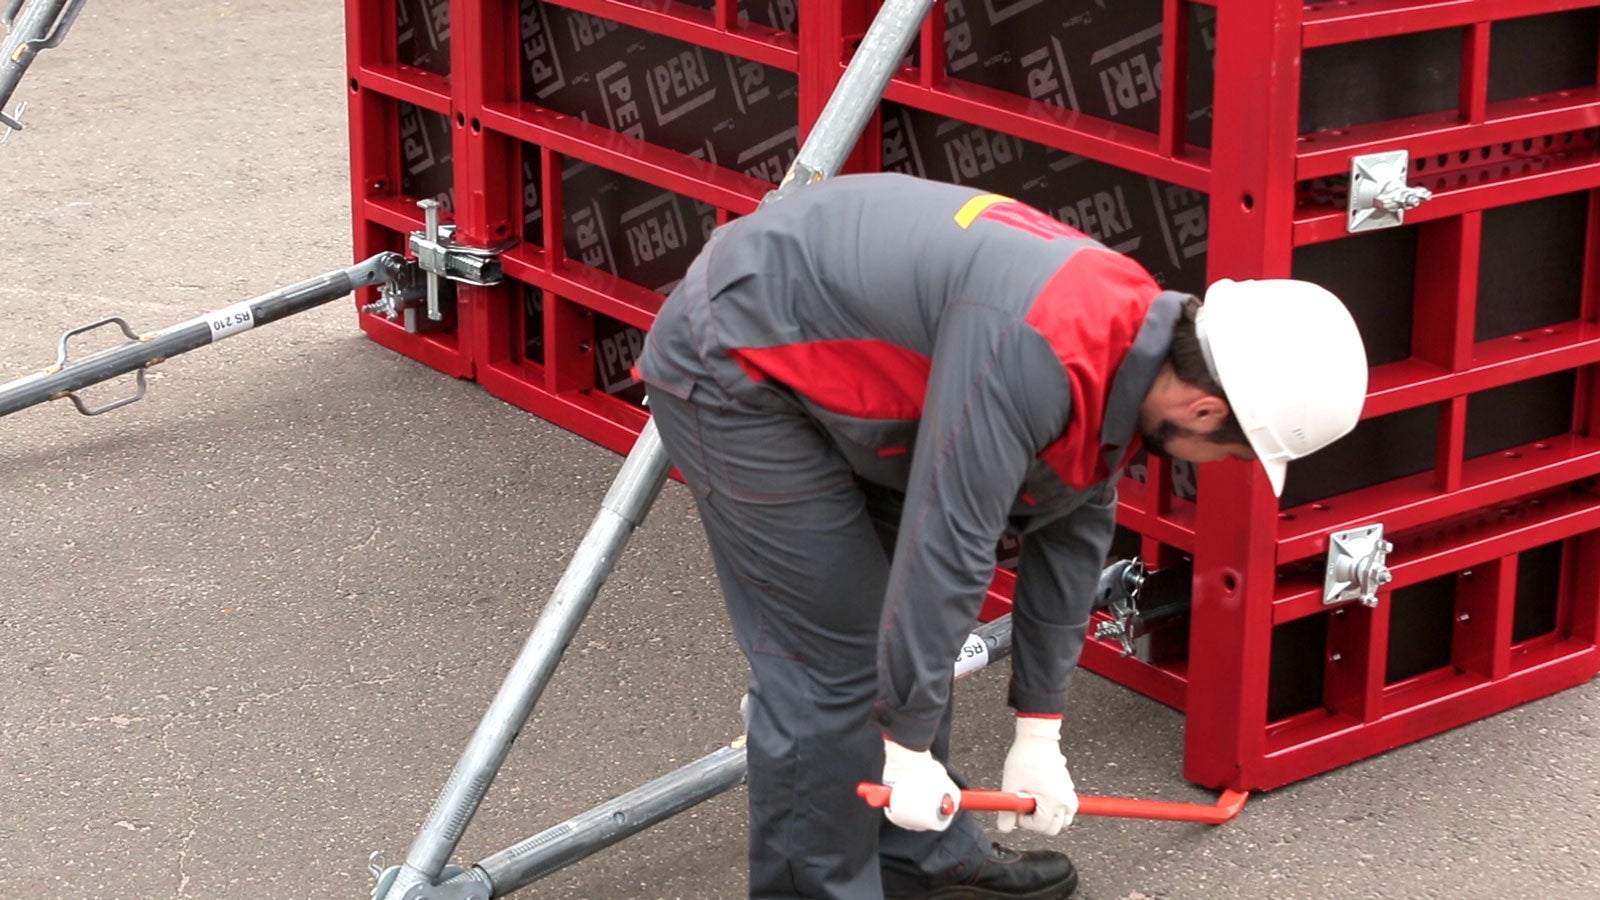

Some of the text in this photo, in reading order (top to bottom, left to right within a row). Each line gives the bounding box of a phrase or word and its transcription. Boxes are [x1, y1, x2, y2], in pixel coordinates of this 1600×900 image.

[654, 47, 710, 105] PERI
[626, 209, 680, 267] PERI
[213, 311, 251, 331] RS 210
[601, 327, 646, 377] PER
[963, 641, 984, 658] RS
